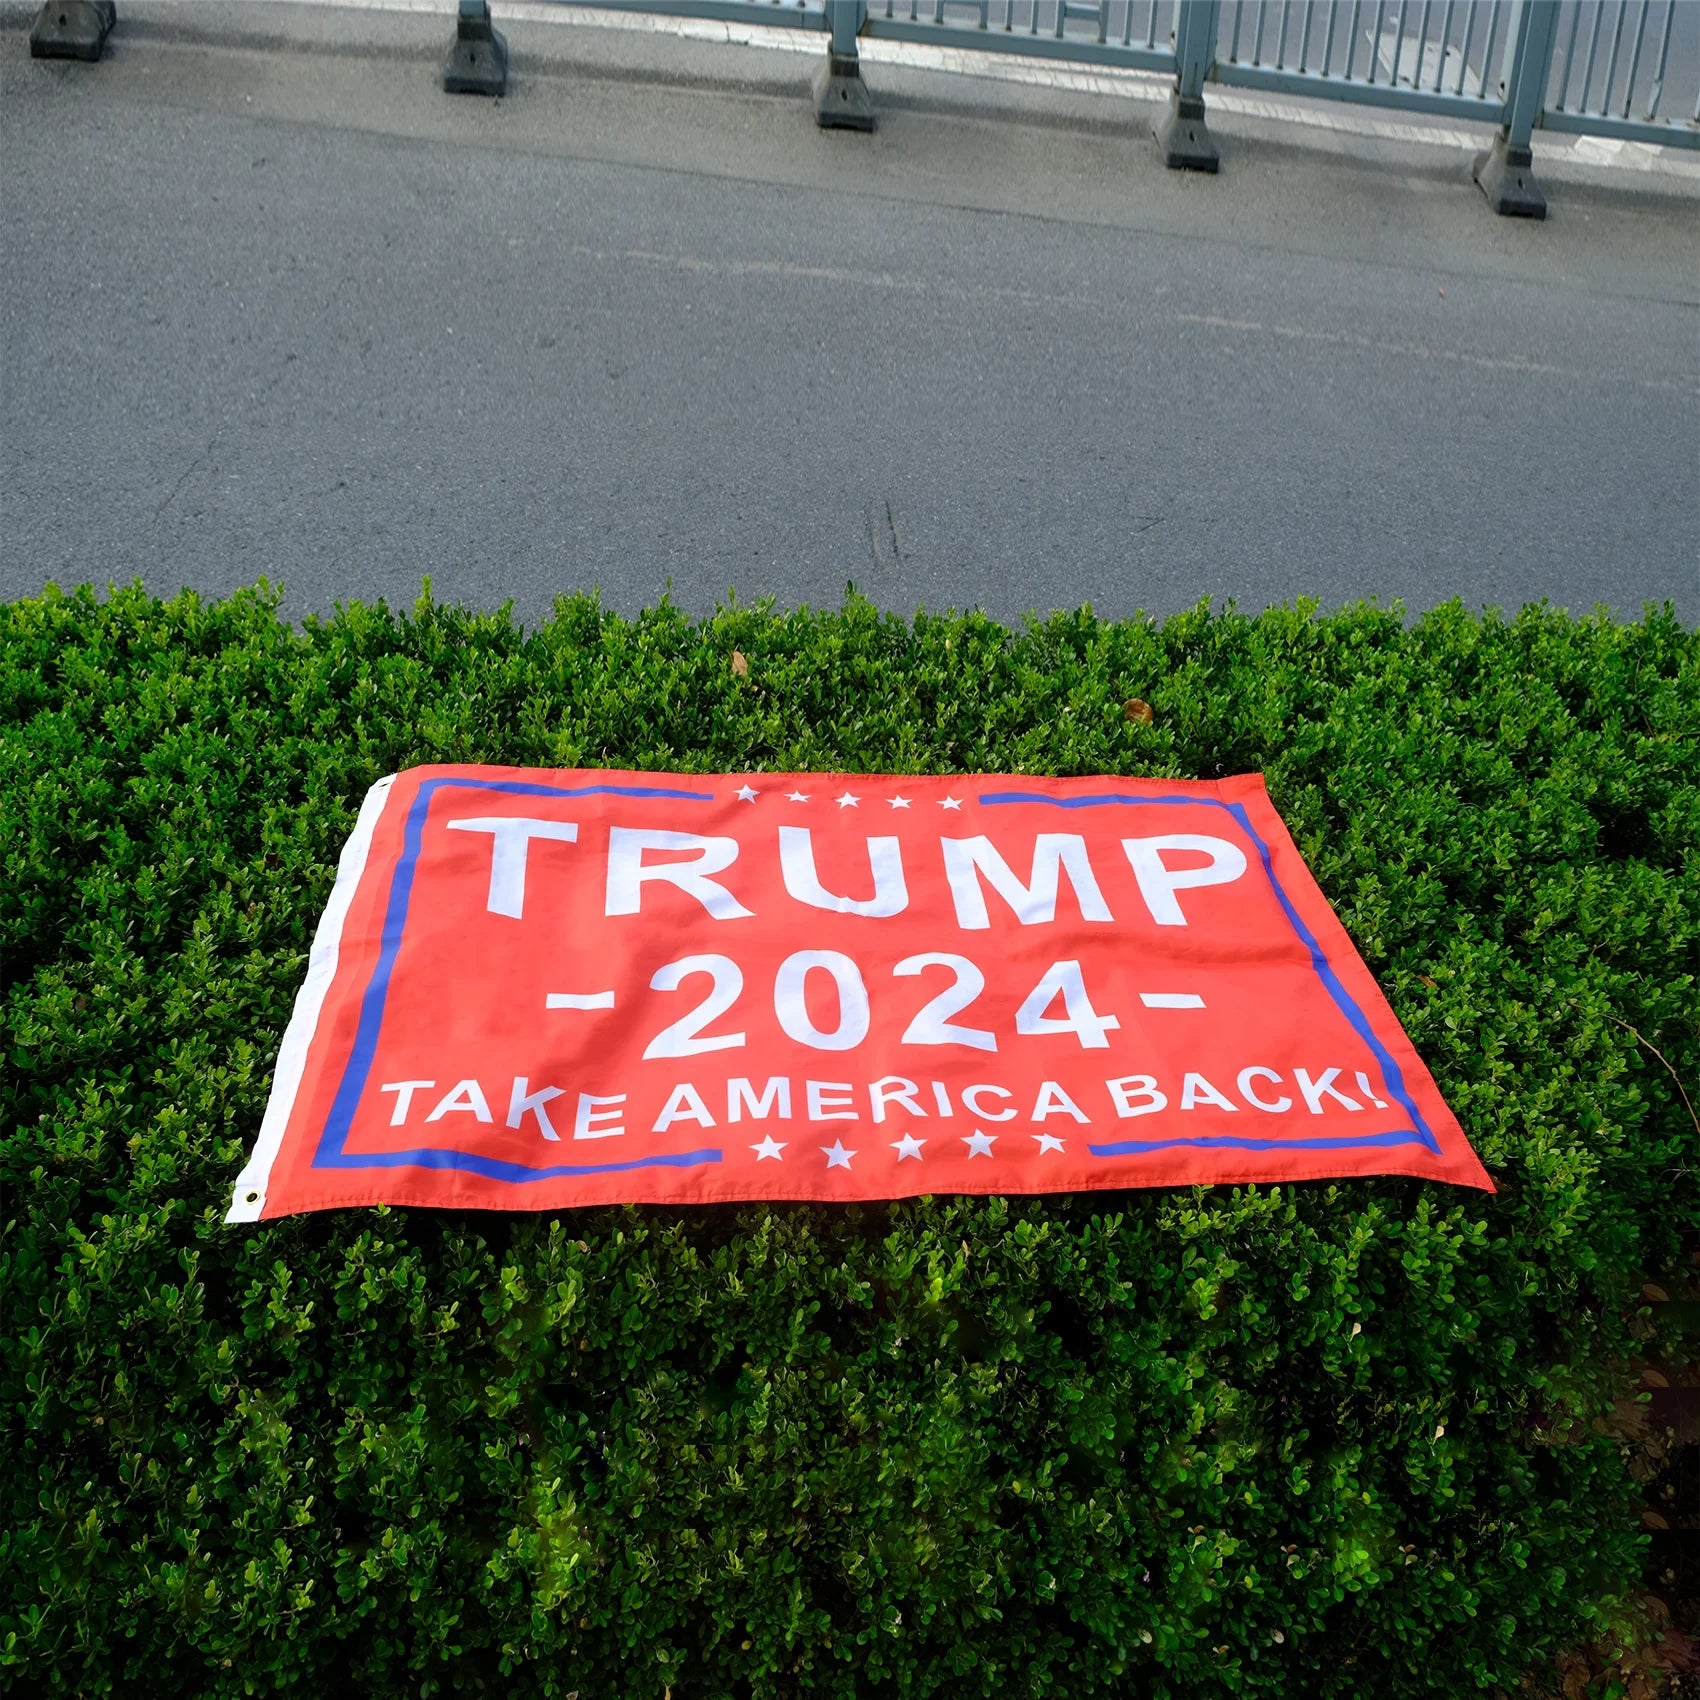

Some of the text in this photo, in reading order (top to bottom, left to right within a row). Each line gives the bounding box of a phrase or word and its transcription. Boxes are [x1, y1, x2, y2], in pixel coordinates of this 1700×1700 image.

[446, 816, 1248, 930] TRUMP
[380, 1065, 1389, 1142] TAKE AMERICA BACK!
